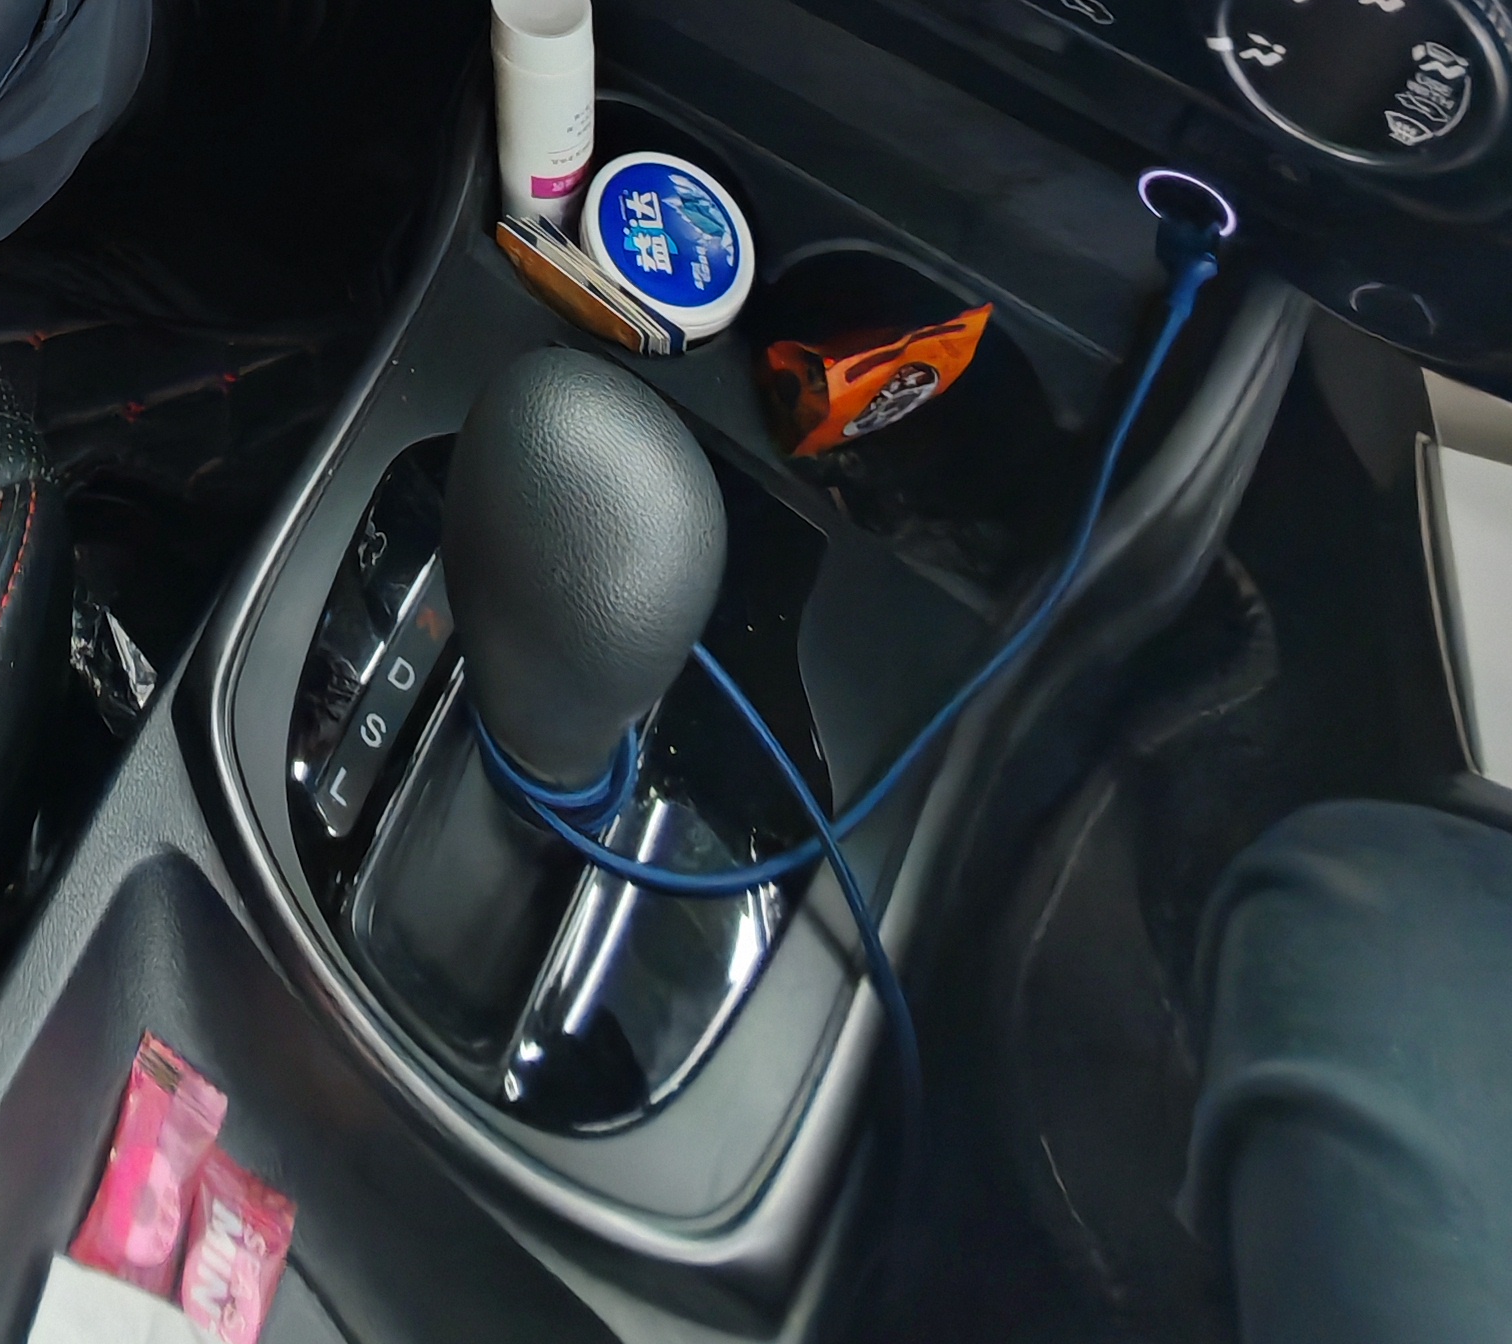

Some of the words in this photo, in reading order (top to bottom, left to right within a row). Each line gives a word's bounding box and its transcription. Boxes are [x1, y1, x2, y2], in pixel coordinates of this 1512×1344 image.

[623, 190, 674, 276] 益达
[387, 656, 416, 691] D
[360, 713, 387, 749] S
[329, 766, 348, 807] L
